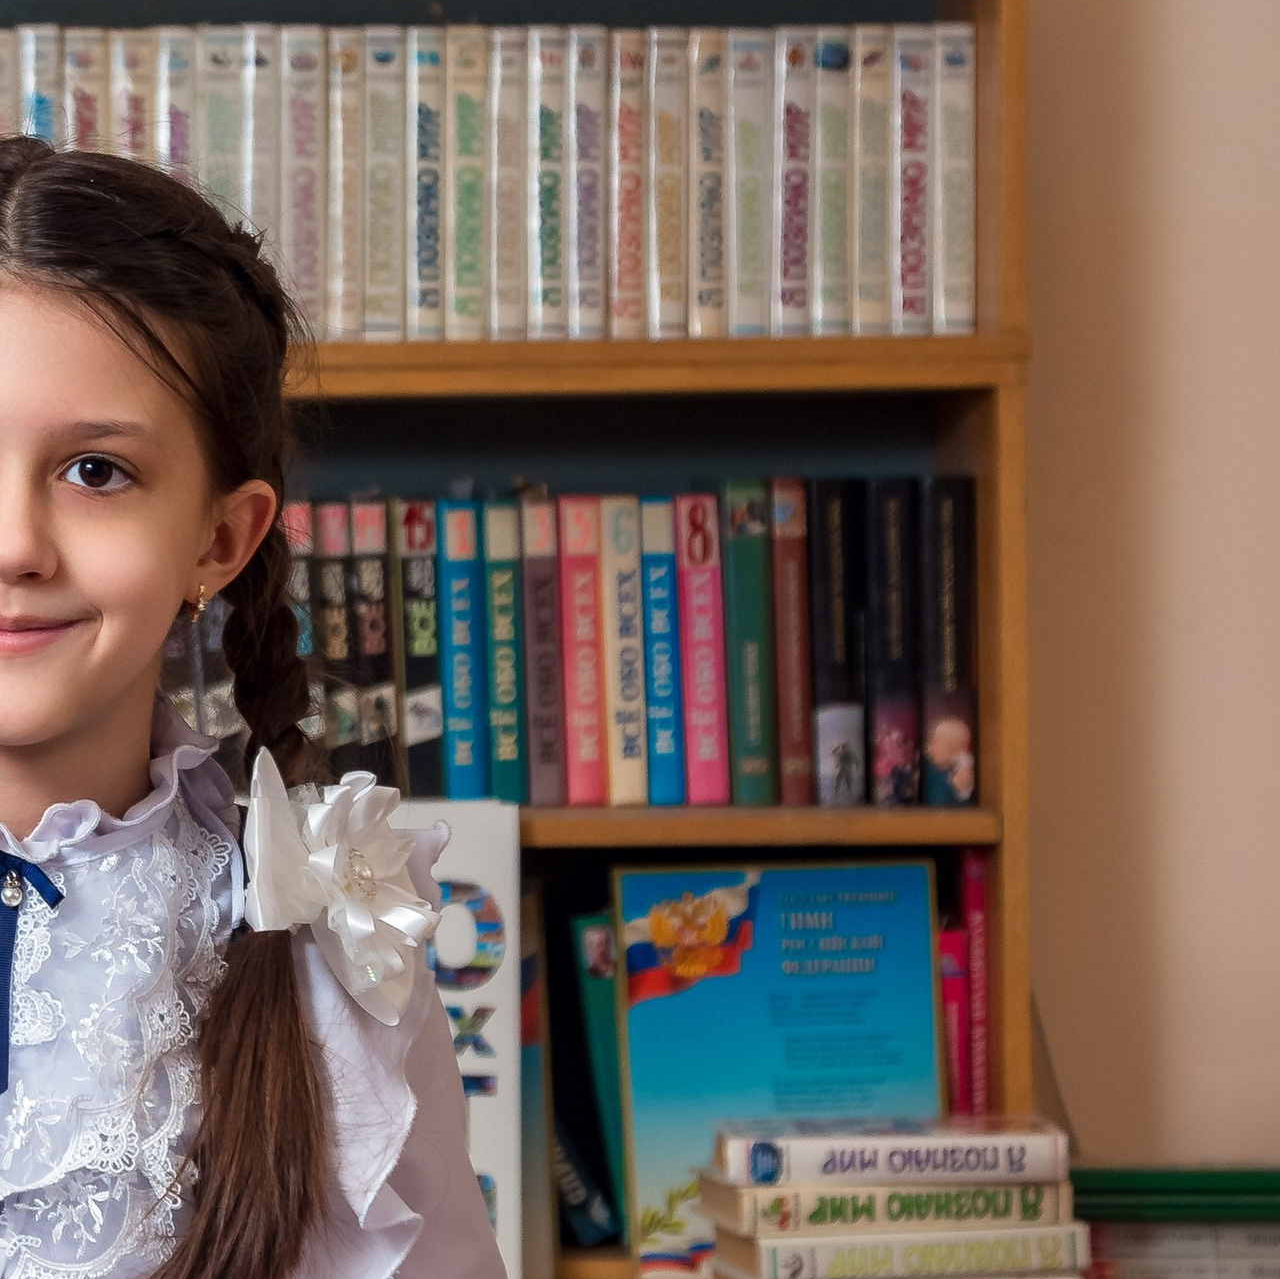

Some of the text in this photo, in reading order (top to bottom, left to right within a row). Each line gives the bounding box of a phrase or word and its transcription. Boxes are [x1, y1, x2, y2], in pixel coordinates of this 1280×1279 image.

[786, 103, 809, 162] МИР
[783, 170, 808, 280] ПОЗНАЮ
[687, 502, 711, 564] 8
[821, 1145, 1027, 1175] Я ПОЗНАЮ МИР
[808, 1185, 1043, 1225] Я ПОЗНАЮ МИР
[827, 1246, 893, 1279] МИР
[903, 1240, 1032, 1272] ПОЗНАЮ
